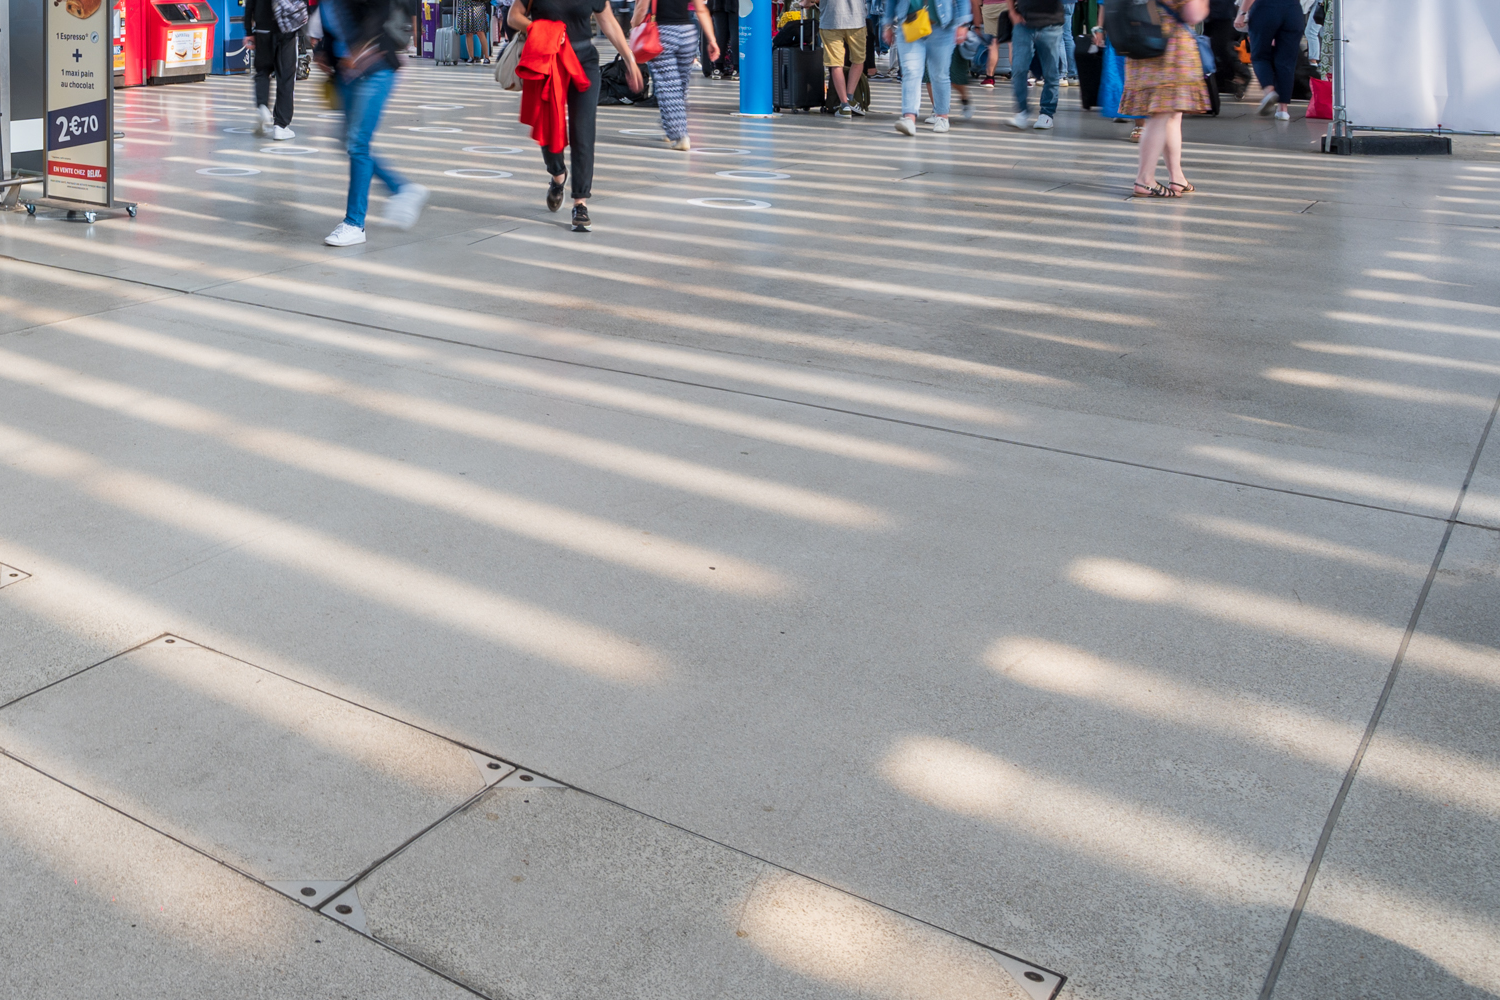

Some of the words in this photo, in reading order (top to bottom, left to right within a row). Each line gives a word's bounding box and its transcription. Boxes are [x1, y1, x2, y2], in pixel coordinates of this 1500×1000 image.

[56, 32, 60, 40] 1
[61, 68, 64, 76] 1
[65, 69, 80, 77] maxi
[80, 70, 94, 78] pain
[69, 81, 95, 90] chocolat
[55, 114, 99, 143] 2€70
[59, 166, 74, 175] VENTE
[73, 168, 86, 176] CHEZ
[87, 169, 102, 178] RELAY
